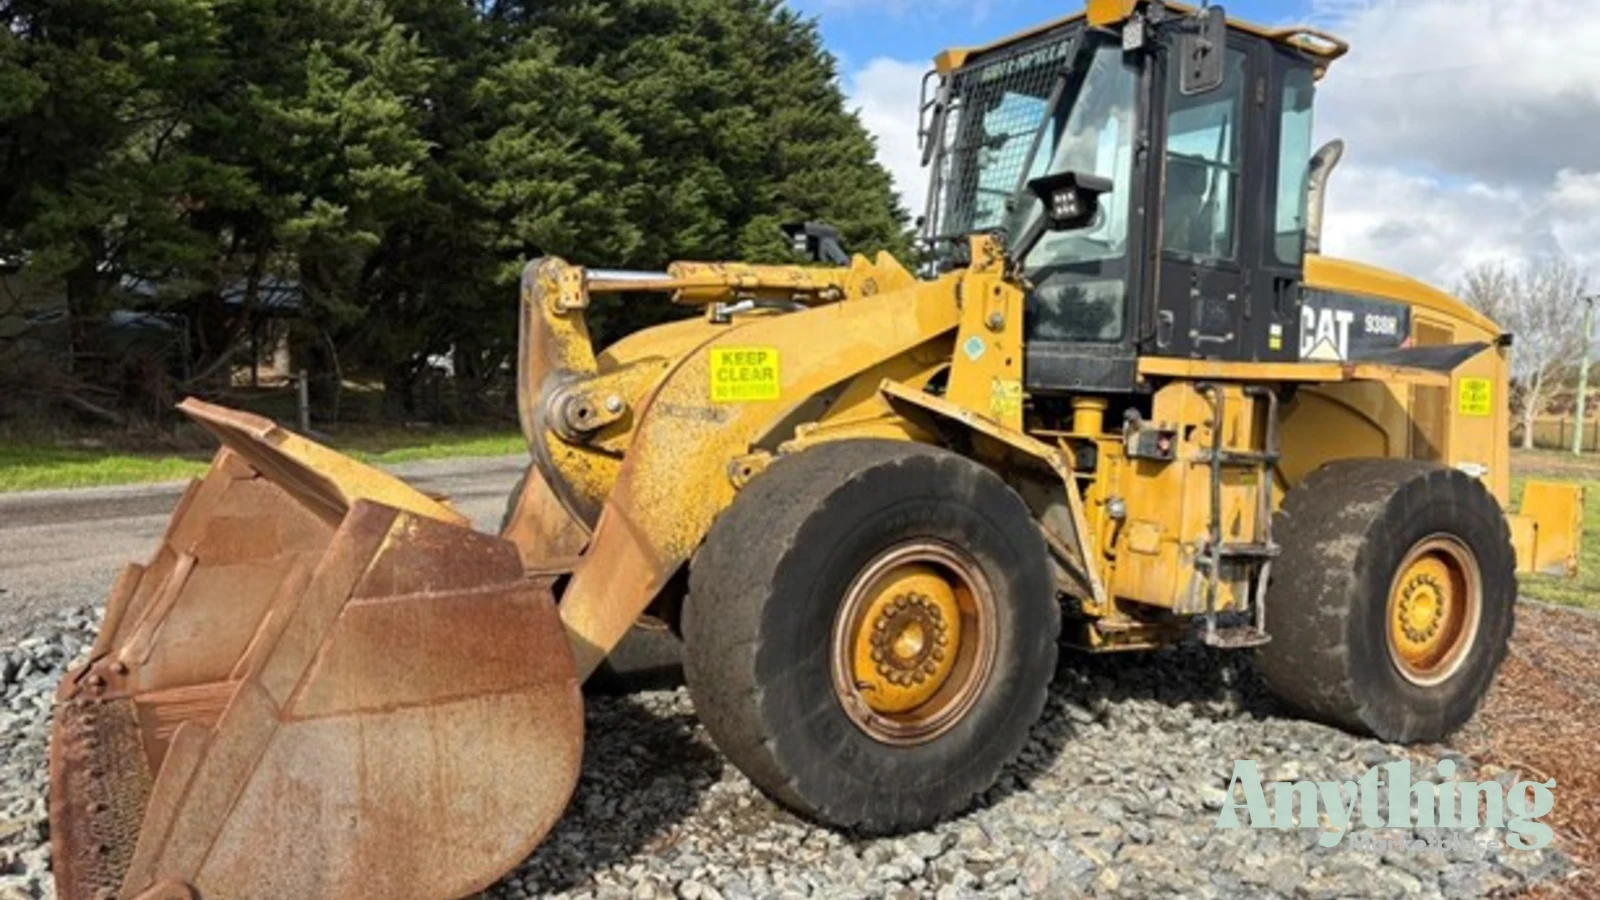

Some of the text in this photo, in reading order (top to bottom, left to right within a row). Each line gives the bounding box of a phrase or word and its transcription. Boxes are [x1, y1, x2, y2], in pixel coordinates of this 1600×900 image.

[1300, 305, 1354, 361] CAT
[721, 351, 767, 365] KEEP
[716, 367, 774, 382] CLEAR
